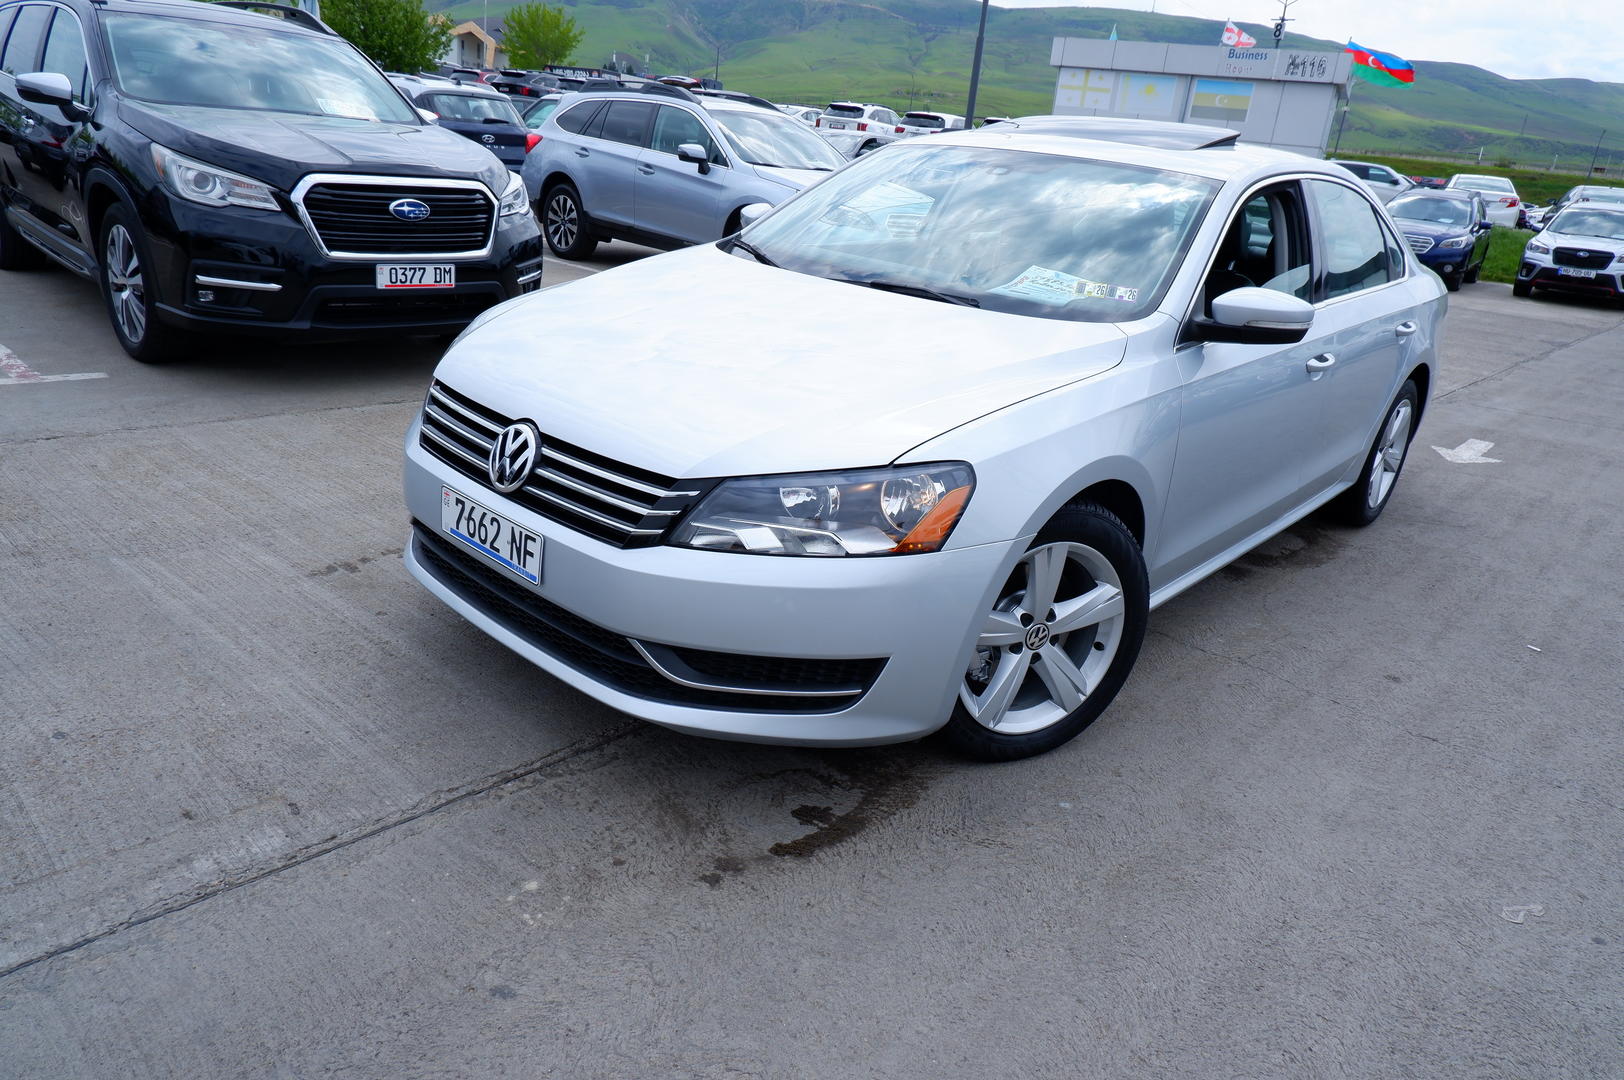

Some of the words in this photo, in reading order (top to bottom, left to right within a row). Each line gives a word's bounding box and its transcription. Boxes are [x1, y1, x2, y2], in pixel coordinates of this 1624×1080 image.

[1273, 23, 1283, 38] 8
[1227, 48, 1268, 61] Business
[389, 267, 426, 284] 0377
[433, 267, 452, 284] DM
[1095, 285, 1106, 296] 26
[1127, 289, 1137, 300] 26
[455, 496, 501, 553] 7662
[509, 526, 537, 569] NF
